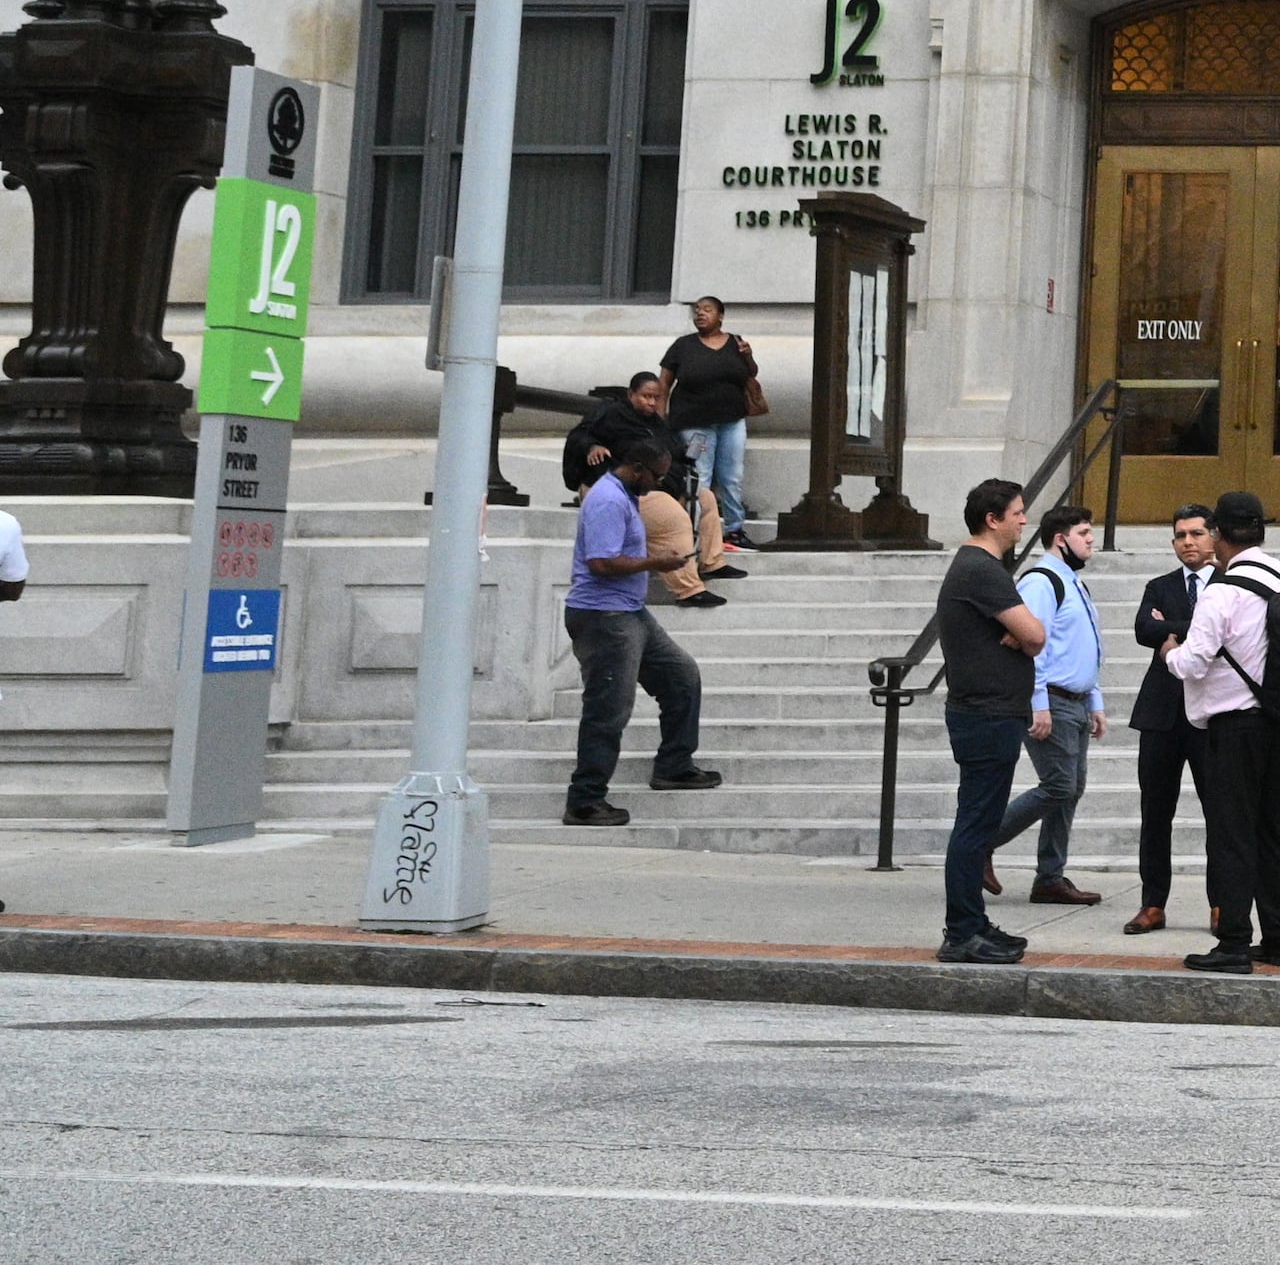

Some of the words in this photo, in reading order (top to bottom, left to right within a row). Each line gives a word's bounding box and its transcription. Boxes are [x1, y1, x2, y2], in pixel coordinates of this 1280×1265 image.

[839, 74, 884, 87] SLATON
[784, 114, 857, 135] LEWIS
[868, 114, 888, 135] R.
[792, 139, 881, 161] SLATON
[722, 165, 880, 187] COURTHOUSE
[735, 209, 770, 228] 136
[249, 199, 301, 314] J2
[1137, 320, 1167, 340] EXIT
[1167, 320, 1203, 340] ONLY
[229, 424, 248, 443] 136
[225, 452, 258, 471] PRYOR
[222, 479, 259, 498] STREET
